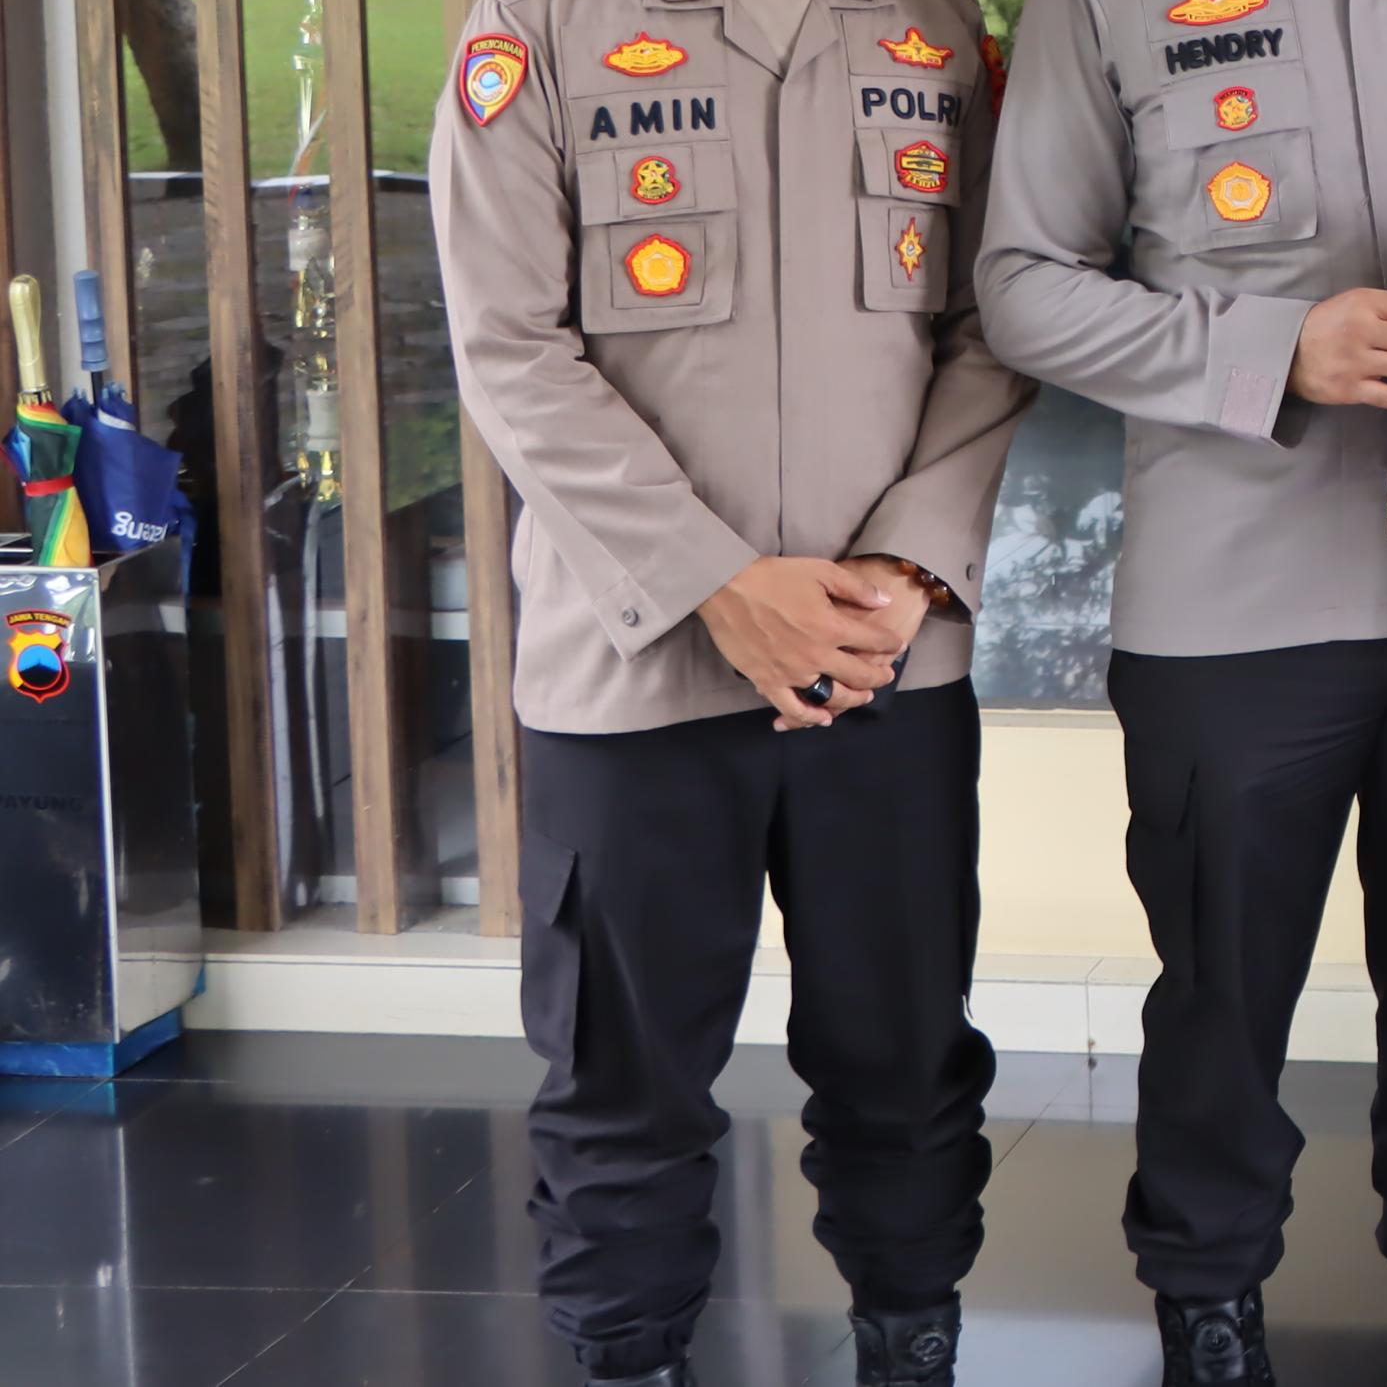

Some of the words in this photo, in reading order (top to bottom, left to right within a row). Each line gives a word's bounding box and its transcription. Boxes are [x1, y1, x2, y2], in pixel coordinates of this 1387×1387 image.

[1165, 27, 1284, 75] HENDRY
[590, 96, 716, 142] AMIN
[861, 87, 962, 128] POLRI
